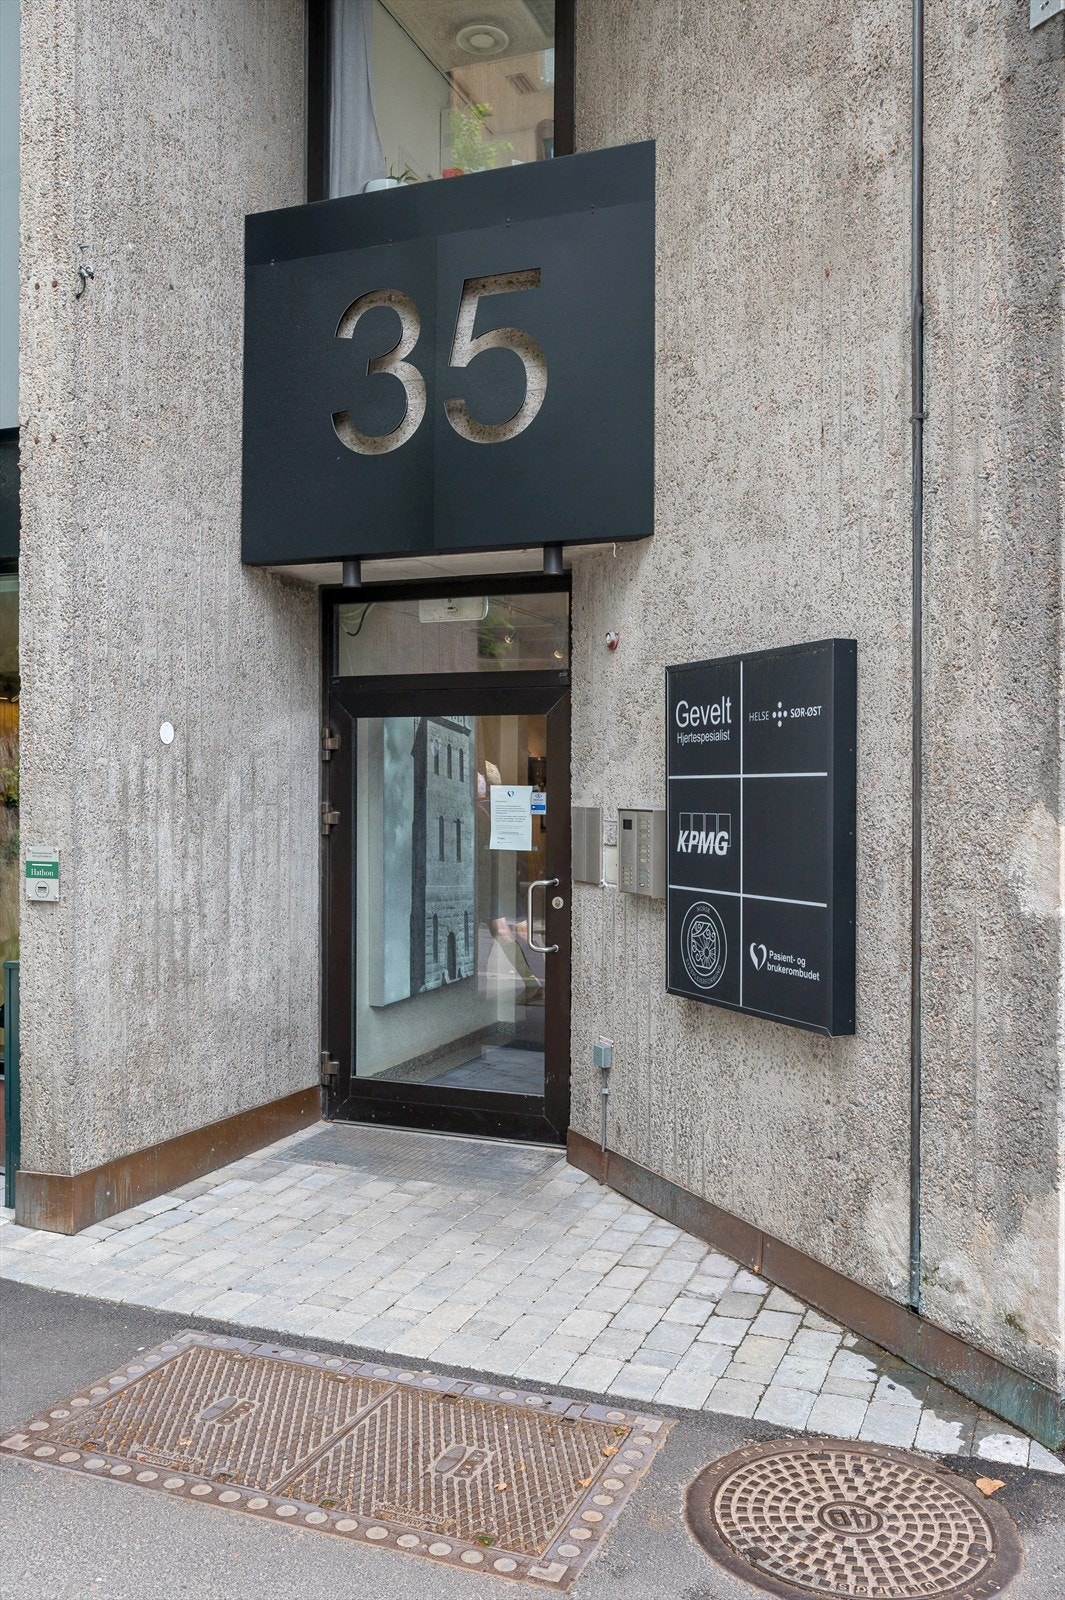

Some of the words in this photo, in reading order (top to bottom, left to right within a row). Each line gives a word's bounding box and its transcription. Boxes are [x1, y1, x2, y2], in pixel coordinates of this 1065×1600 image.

[331, 268, 548, 456] 35
[675, 696, 732, 728] Gevelt
[748, 710, 769, 722] HELSE
[790, 705, 822, 719] SØR-ØST
[676, 729, 730, 746] Hjertespesialist
[677, 830, 729, 856] KPMG
[31, 868, 54, 877] Hathon
[769, 949, 796, 964] Pasient-
[796, 956, 806, 967] og
[766, 961, 820, 981] brukerombudet
